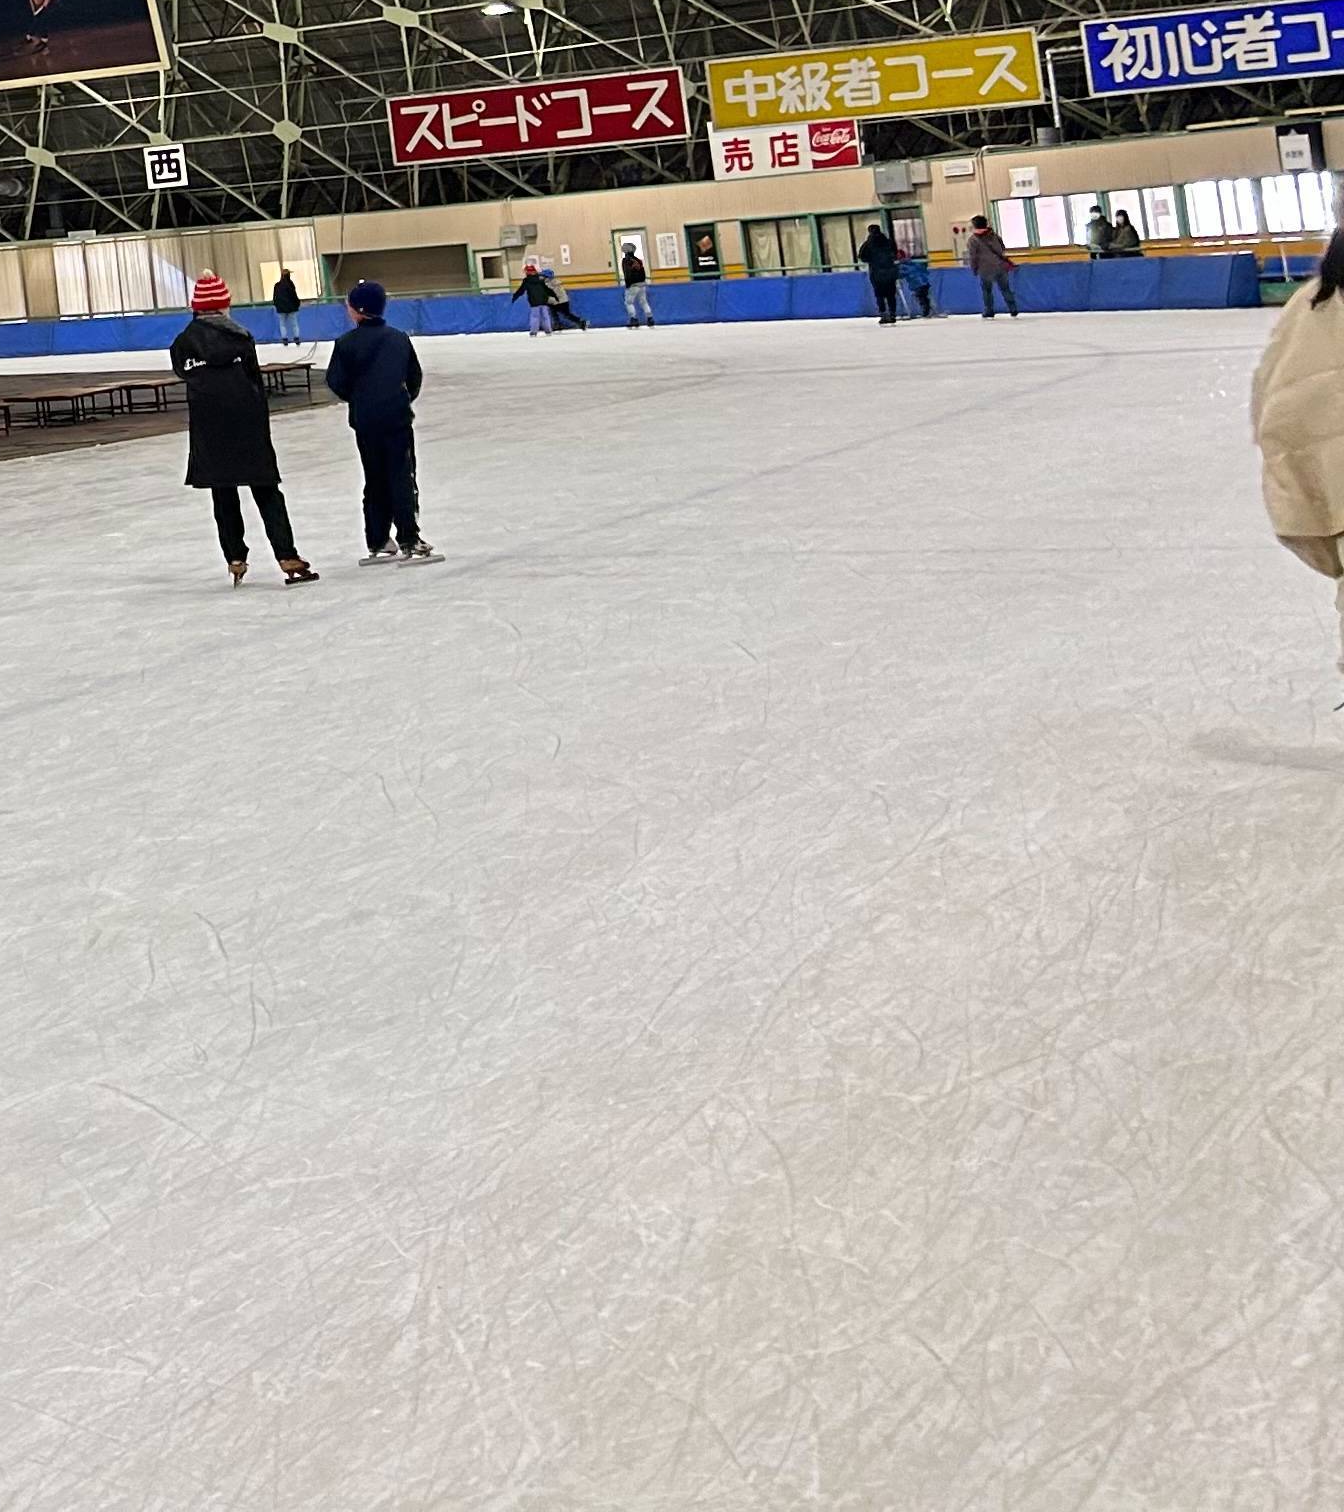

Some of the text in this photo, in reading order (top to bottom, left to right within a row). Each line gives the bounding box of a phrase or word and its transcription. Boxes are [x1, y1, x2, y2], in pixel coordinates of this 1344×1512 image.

[723, 45, 1029, 118] 中級者コース
[1098, 10, 1344, 83] 初心者コ
[399, 78, 675, 153] スピードコース
[147, 148, 182, 185] 西
[721, 131, 800, 174] 売店
